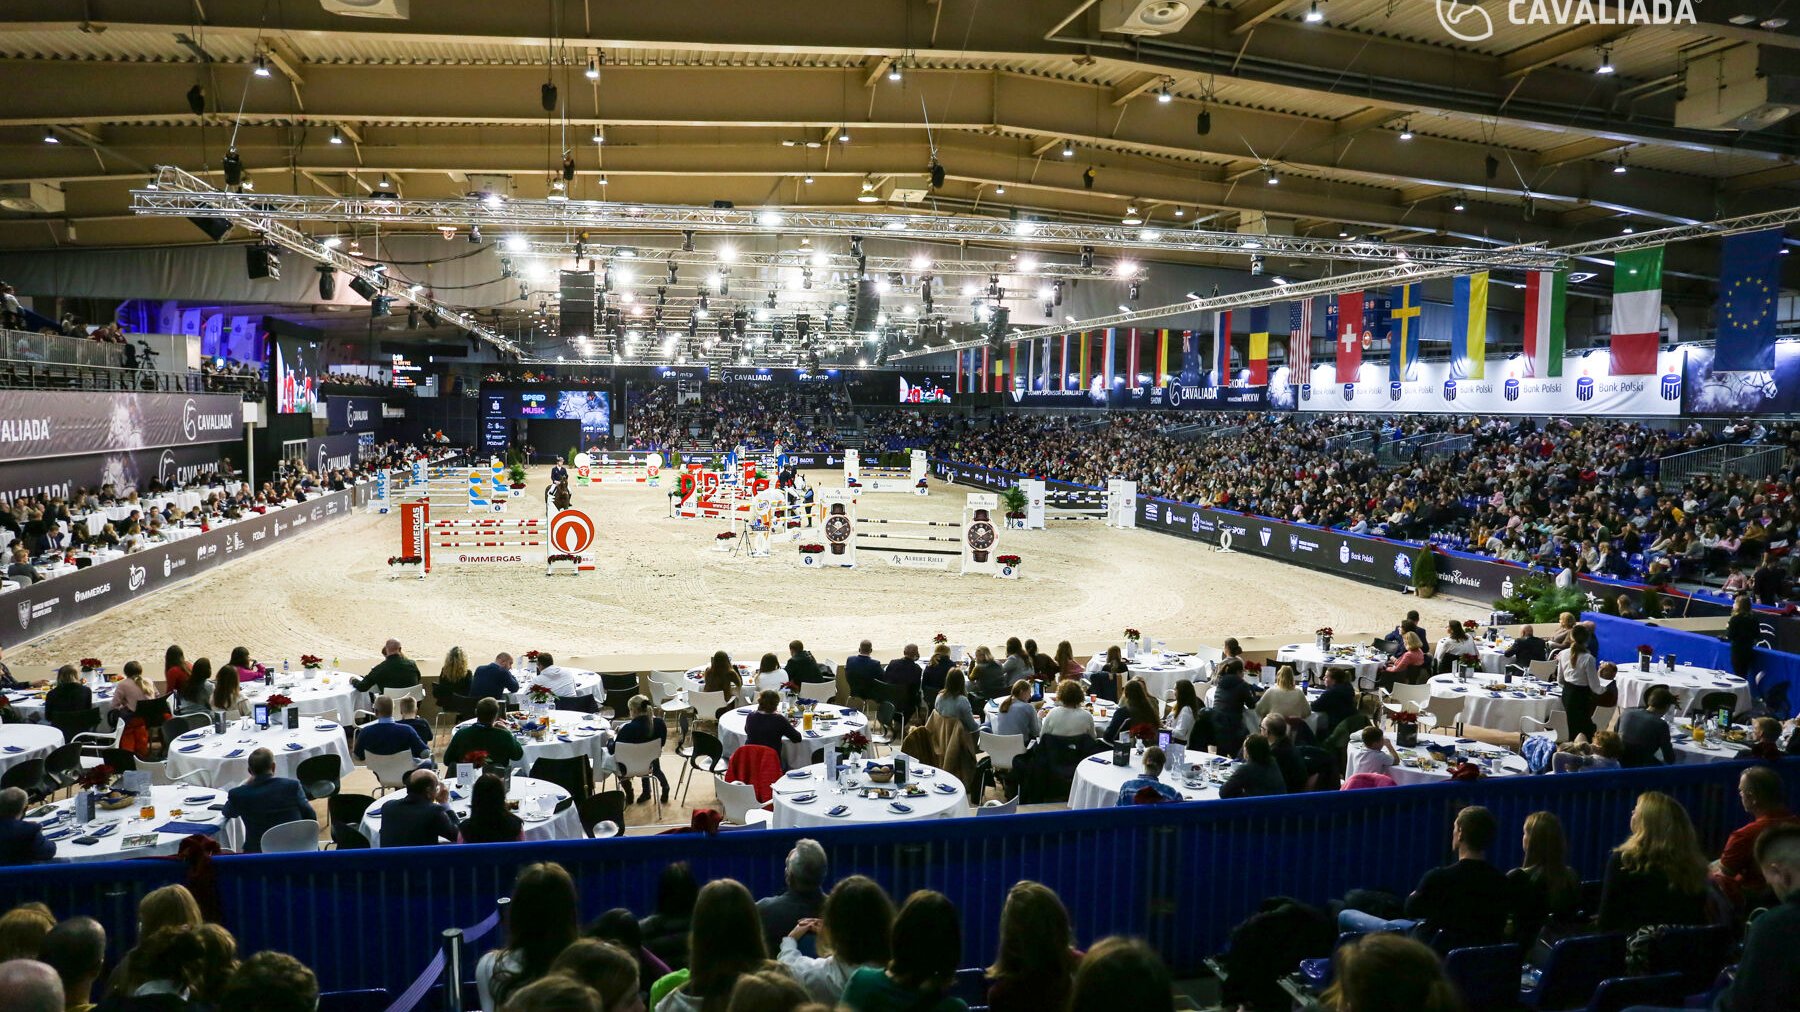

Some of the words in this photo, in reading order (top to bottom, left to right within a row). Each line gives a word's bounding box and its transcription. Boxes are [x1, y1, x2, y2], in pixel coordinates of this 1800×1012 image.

[1181, 387, 1218, 399] CAVALIADA
[1523, 384, 1539, 393] Bank
[1541, 384, 1562, 393] Polski
[1599, 383, 1618, 392] Bank
[1620, 382, 1644, 392] Polski
[353, 410, 368, 421] CAVALIADA
[198, 413, 233, 431] CAVALIADA
[0, 418, 49, 442] ALIADA
[412, 507, 421, 557] IMMERGAS
[467, 555, 522, 563] IMMERGAS
[1351, 552, 1361, 561] Bank
[1362, 554, 1374, 564] Polski
[80, 583, 111, 600] IMMERGAS
